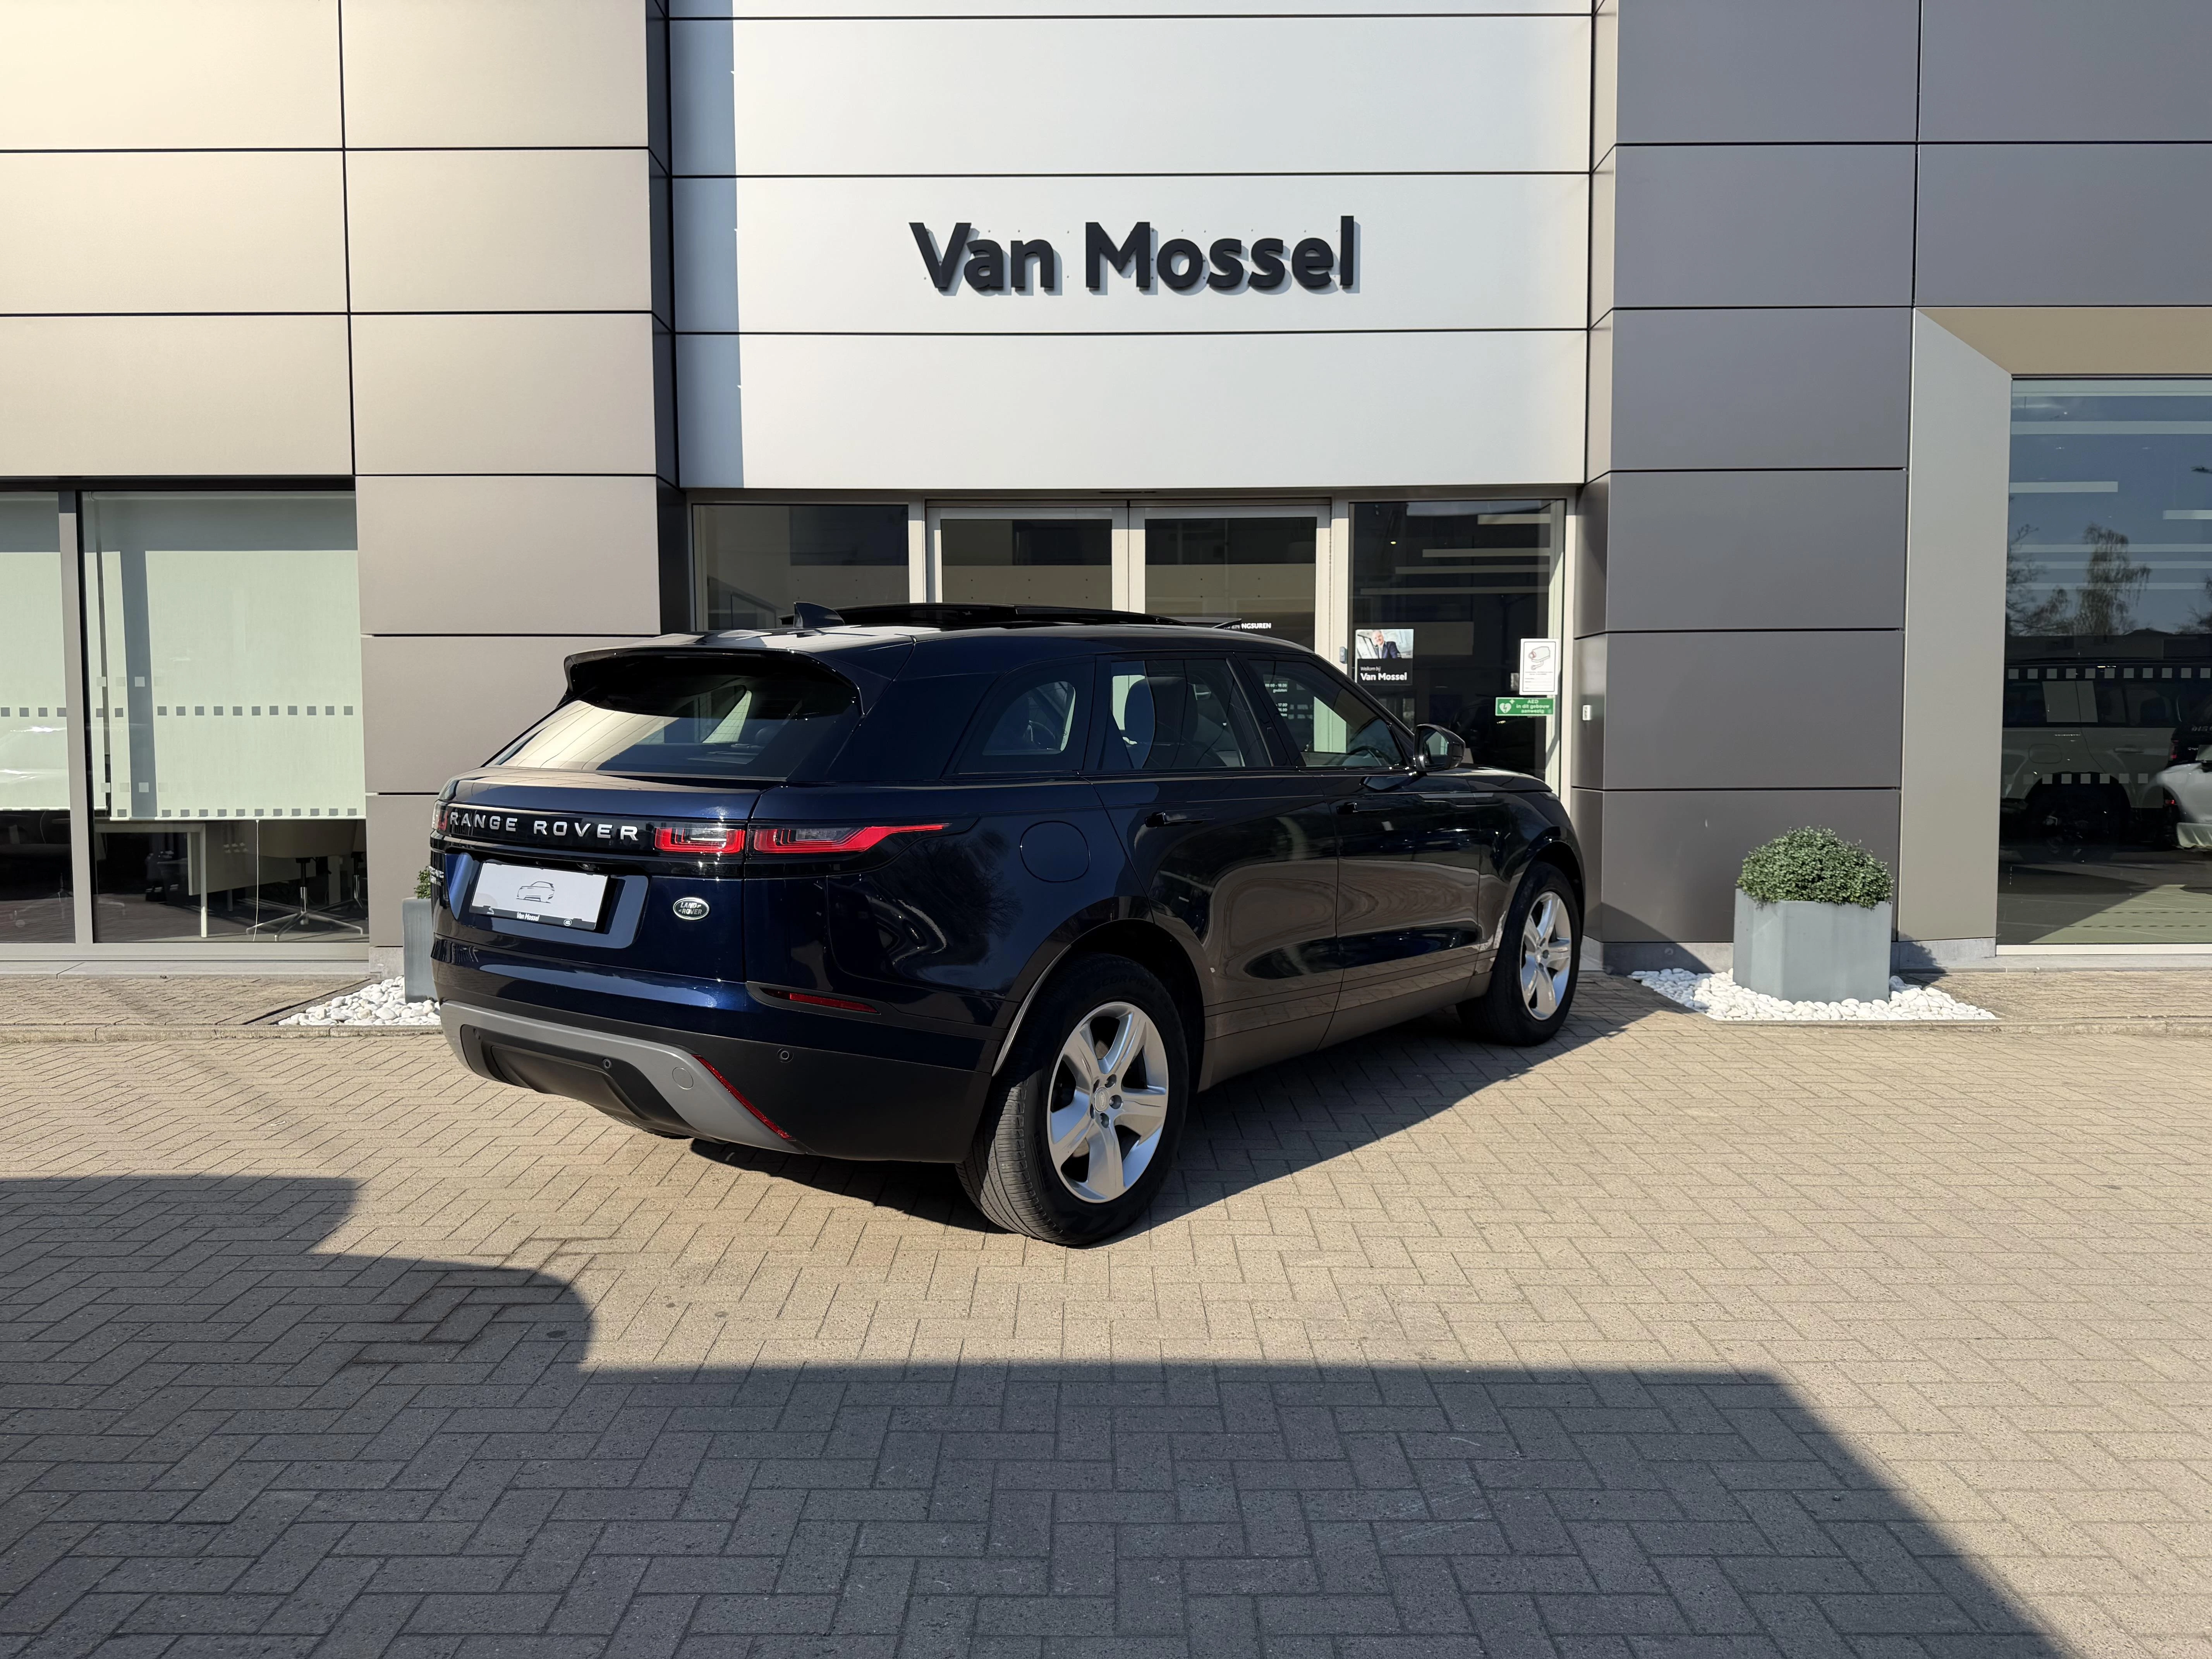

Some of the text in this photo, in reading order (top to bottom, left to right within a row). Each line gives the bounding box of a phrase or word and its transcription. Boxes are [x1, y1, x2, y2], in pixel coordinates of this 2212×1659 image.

[909, 215, 1354, 290] Van Mossel
[1378, 672, 1407, 680] Mossel
[449, 811, 639, 841] RANGE ROVER
[524, 913, 540, 921] Mossel
